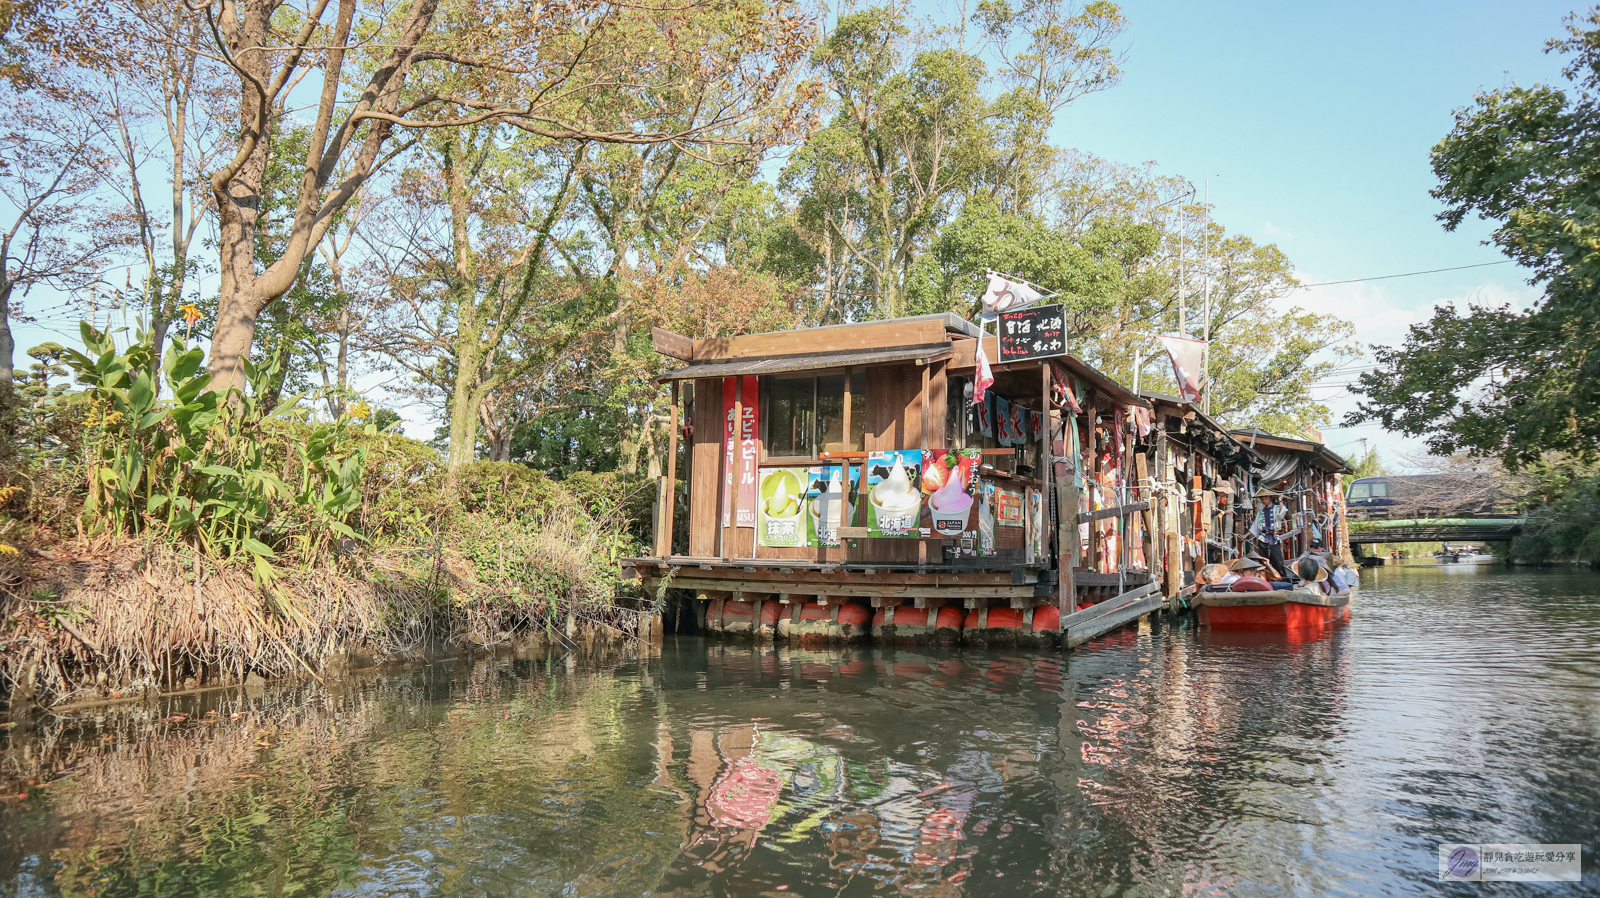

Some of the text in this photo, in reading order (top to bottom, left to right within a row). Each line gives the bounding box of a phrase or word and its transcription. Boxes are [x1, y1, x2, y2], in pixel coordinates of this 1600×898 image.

[968, 449, 980, 496] あまおう
[724, 512, 755, 522] YBISU
[880, 515, 913, 531] 北海道
[767, 521, 796, 534] 抹茶
[819, 526, 838, 542] 北海
